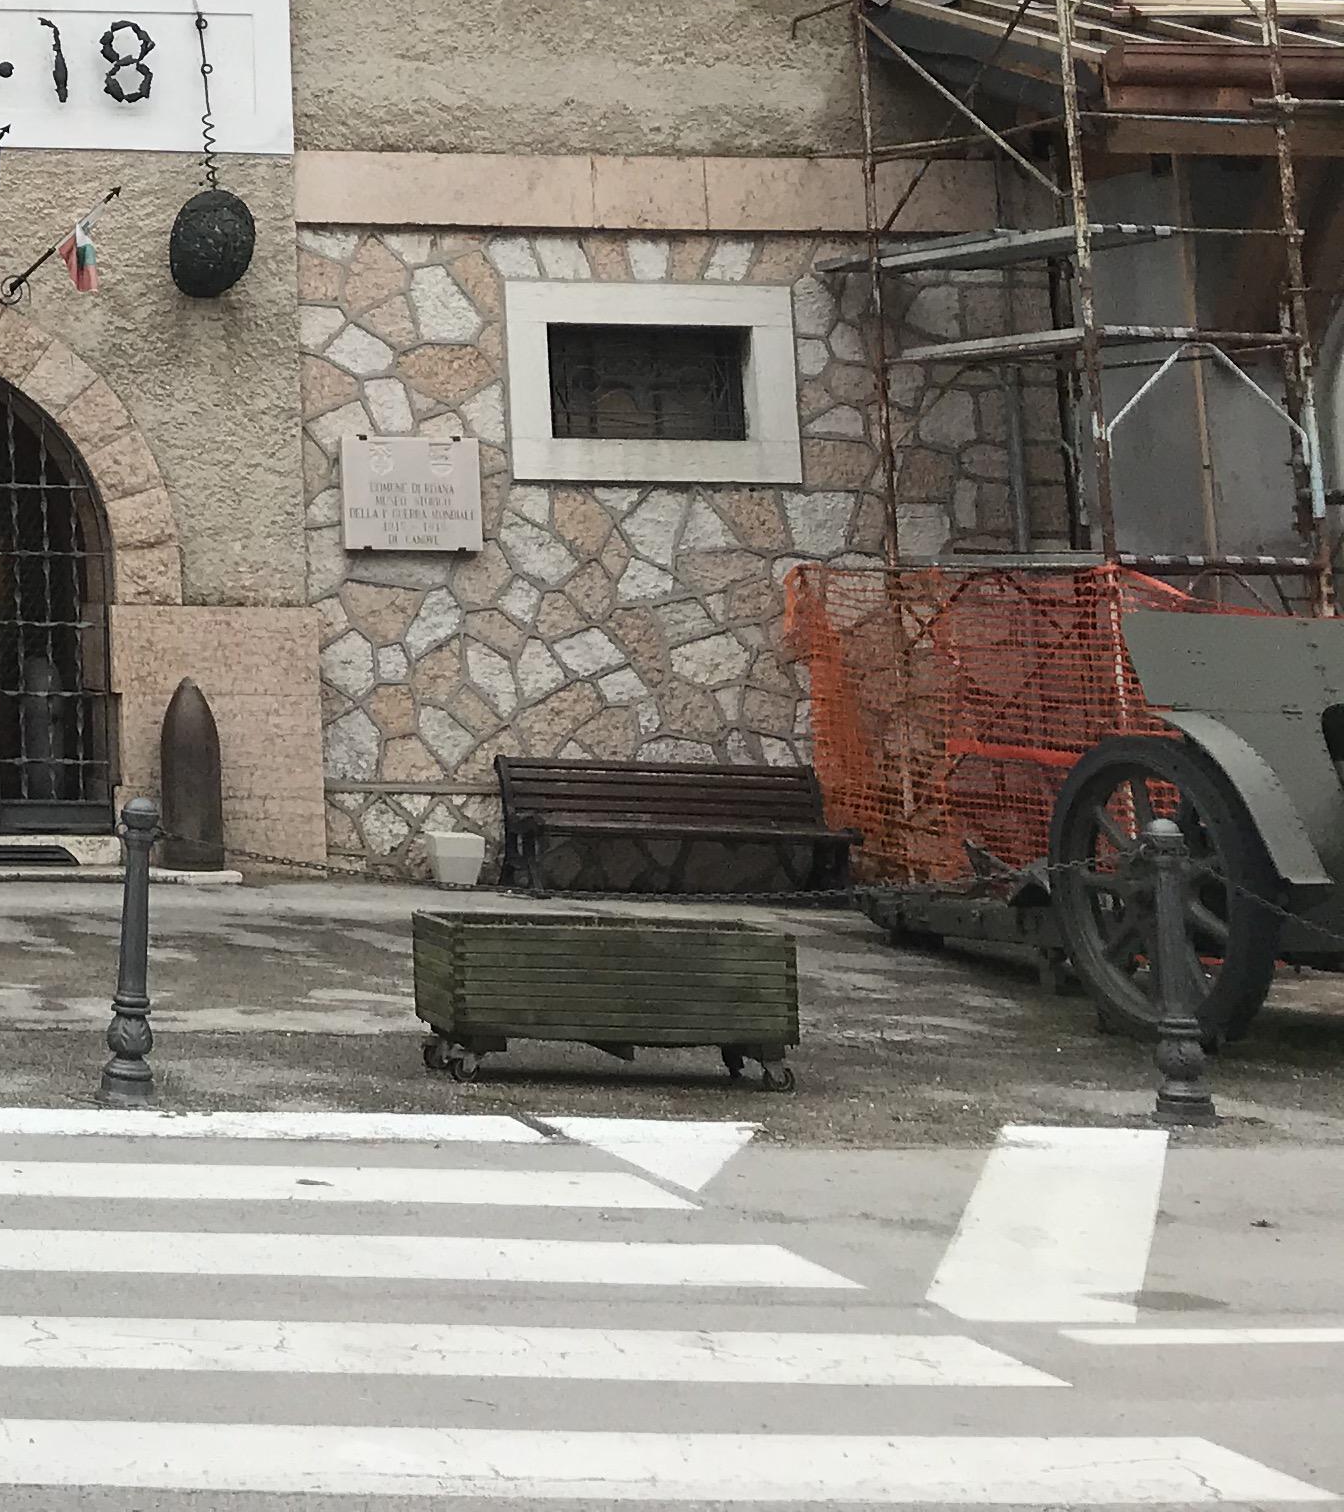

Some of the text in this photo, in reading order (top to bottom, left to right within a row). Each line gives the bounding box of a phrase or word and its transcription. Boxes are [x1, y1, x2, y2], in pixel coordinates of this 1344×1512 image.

[412, 482, 421, 494] DI
[375, 495, 407, 506] MUSEO
[349, 507, 378, 519] DELLA
